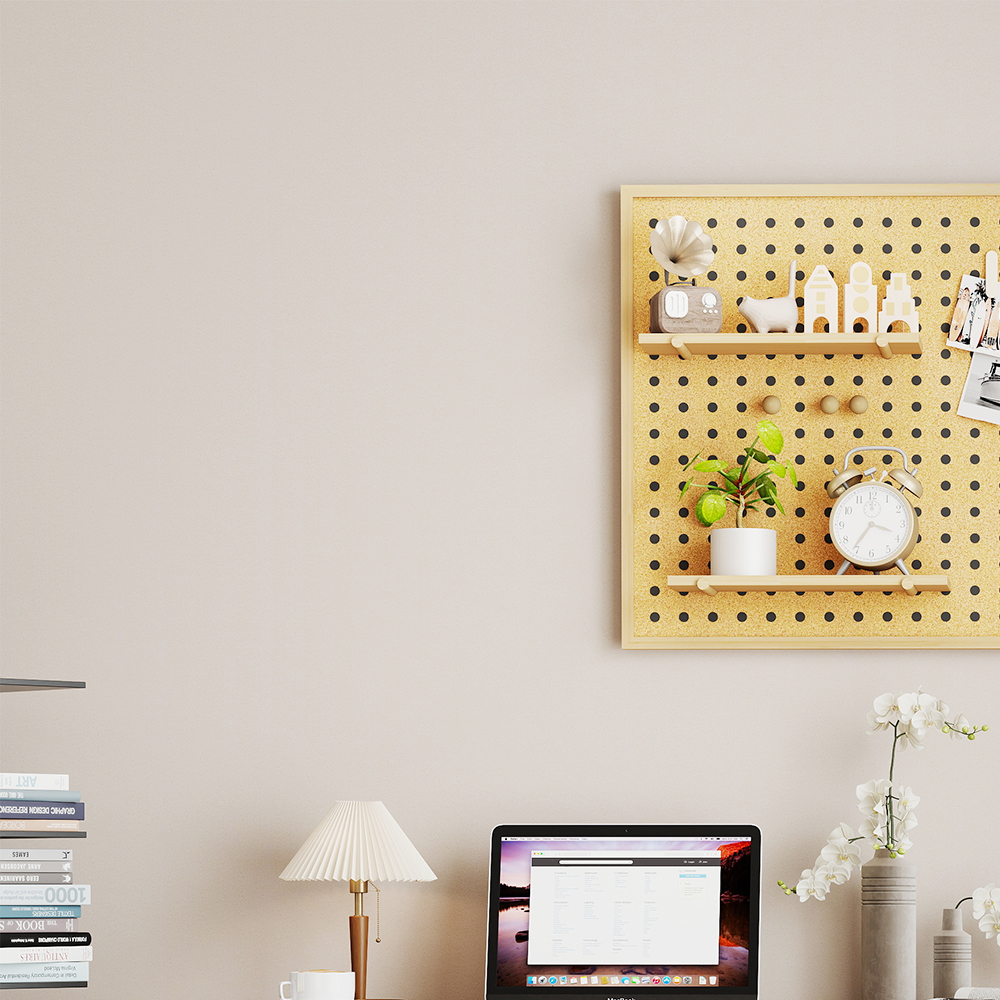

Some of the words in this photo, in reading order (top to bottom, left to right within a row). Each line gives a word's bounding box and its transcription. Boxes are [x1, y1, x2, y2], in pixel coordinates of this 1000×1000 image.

[856, 496, 863, 504] 11
[869, 492, 877, 500] 12
[886, 495, 889, 503] 1
[844, 507, 852, 515] 10
[896, 505, 902, 514] 2
[900, 520, 906, 528] 3
[843, 536, 848, 544] 8
[854, 546, 860, 554] 7
[886, 545, 891, 554] 5
[869, 550, 874, 558] 6
[16, 776, 37, 787] ART
[29, 806, 50, 814] DESIGN
[51, 806, 76, 815] GRAPHIC
[45, 887, 86, 904] 1000
[16, 920, 45, 930] BOOK
